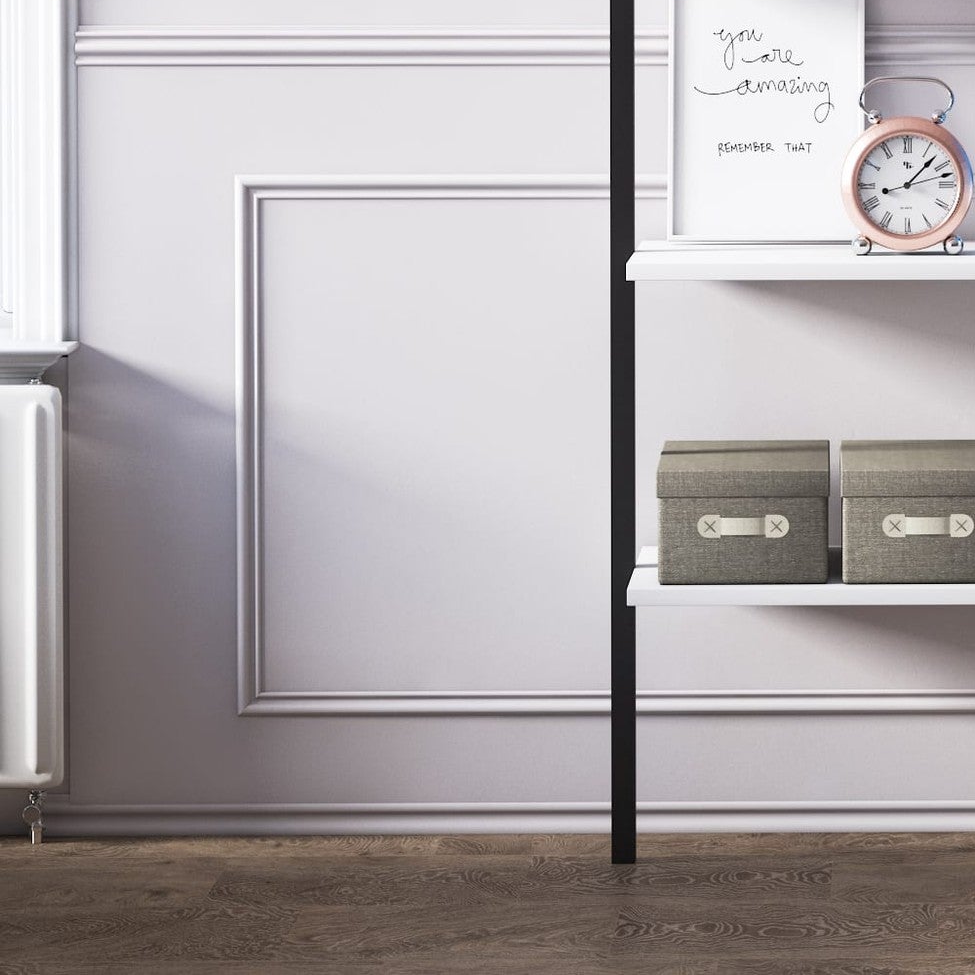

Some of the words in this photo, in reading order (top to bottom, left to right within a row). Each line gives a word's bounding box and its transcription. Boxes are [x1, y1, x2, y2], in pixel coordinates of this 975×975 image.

[713, 29, 763, 70] you
[742, 49, 803, 66] are
[694, 76, 834, 123] amazing
[718, 142, 774, 156] REMEMBER
[785, 143, 812, 153] THAT
